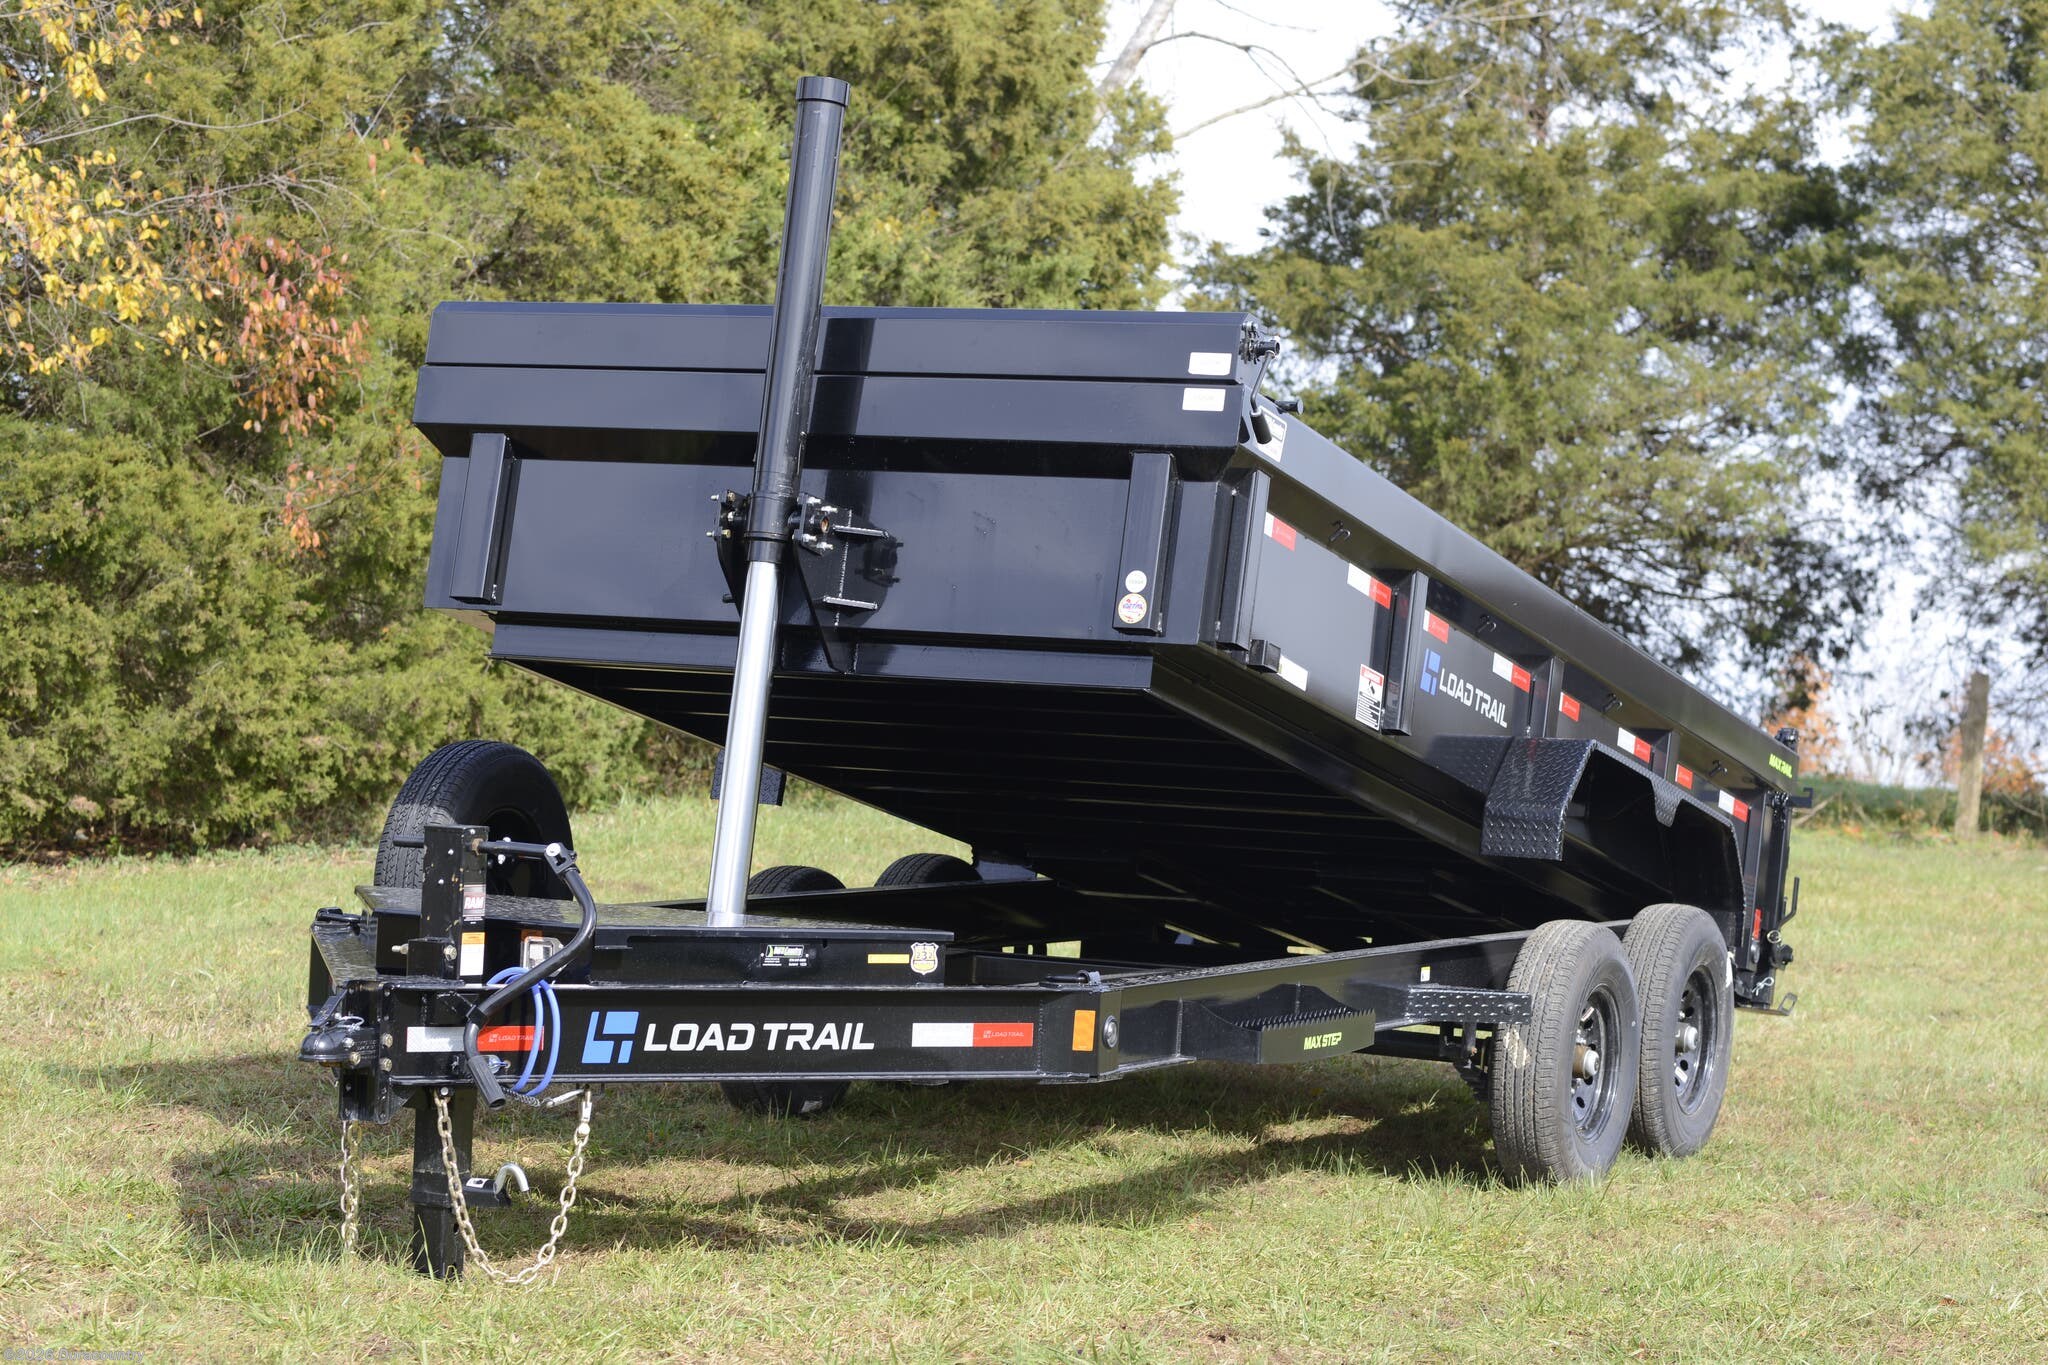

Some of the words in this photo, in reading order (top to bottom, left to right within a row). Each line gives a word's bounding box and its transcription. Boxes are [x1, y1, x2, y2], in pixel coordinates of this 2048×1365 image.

[1439, 667, 1474, 707] LOAD
[1475, 688, 1508, 729] TRAIL
[643, 1023, 756, 1052] LOAD
[763, 1022, 875, 1051] TRAIL
[1303, 1035, 1322, 1050] MAX
[1321, 1031, 1342, 1047] STEP
